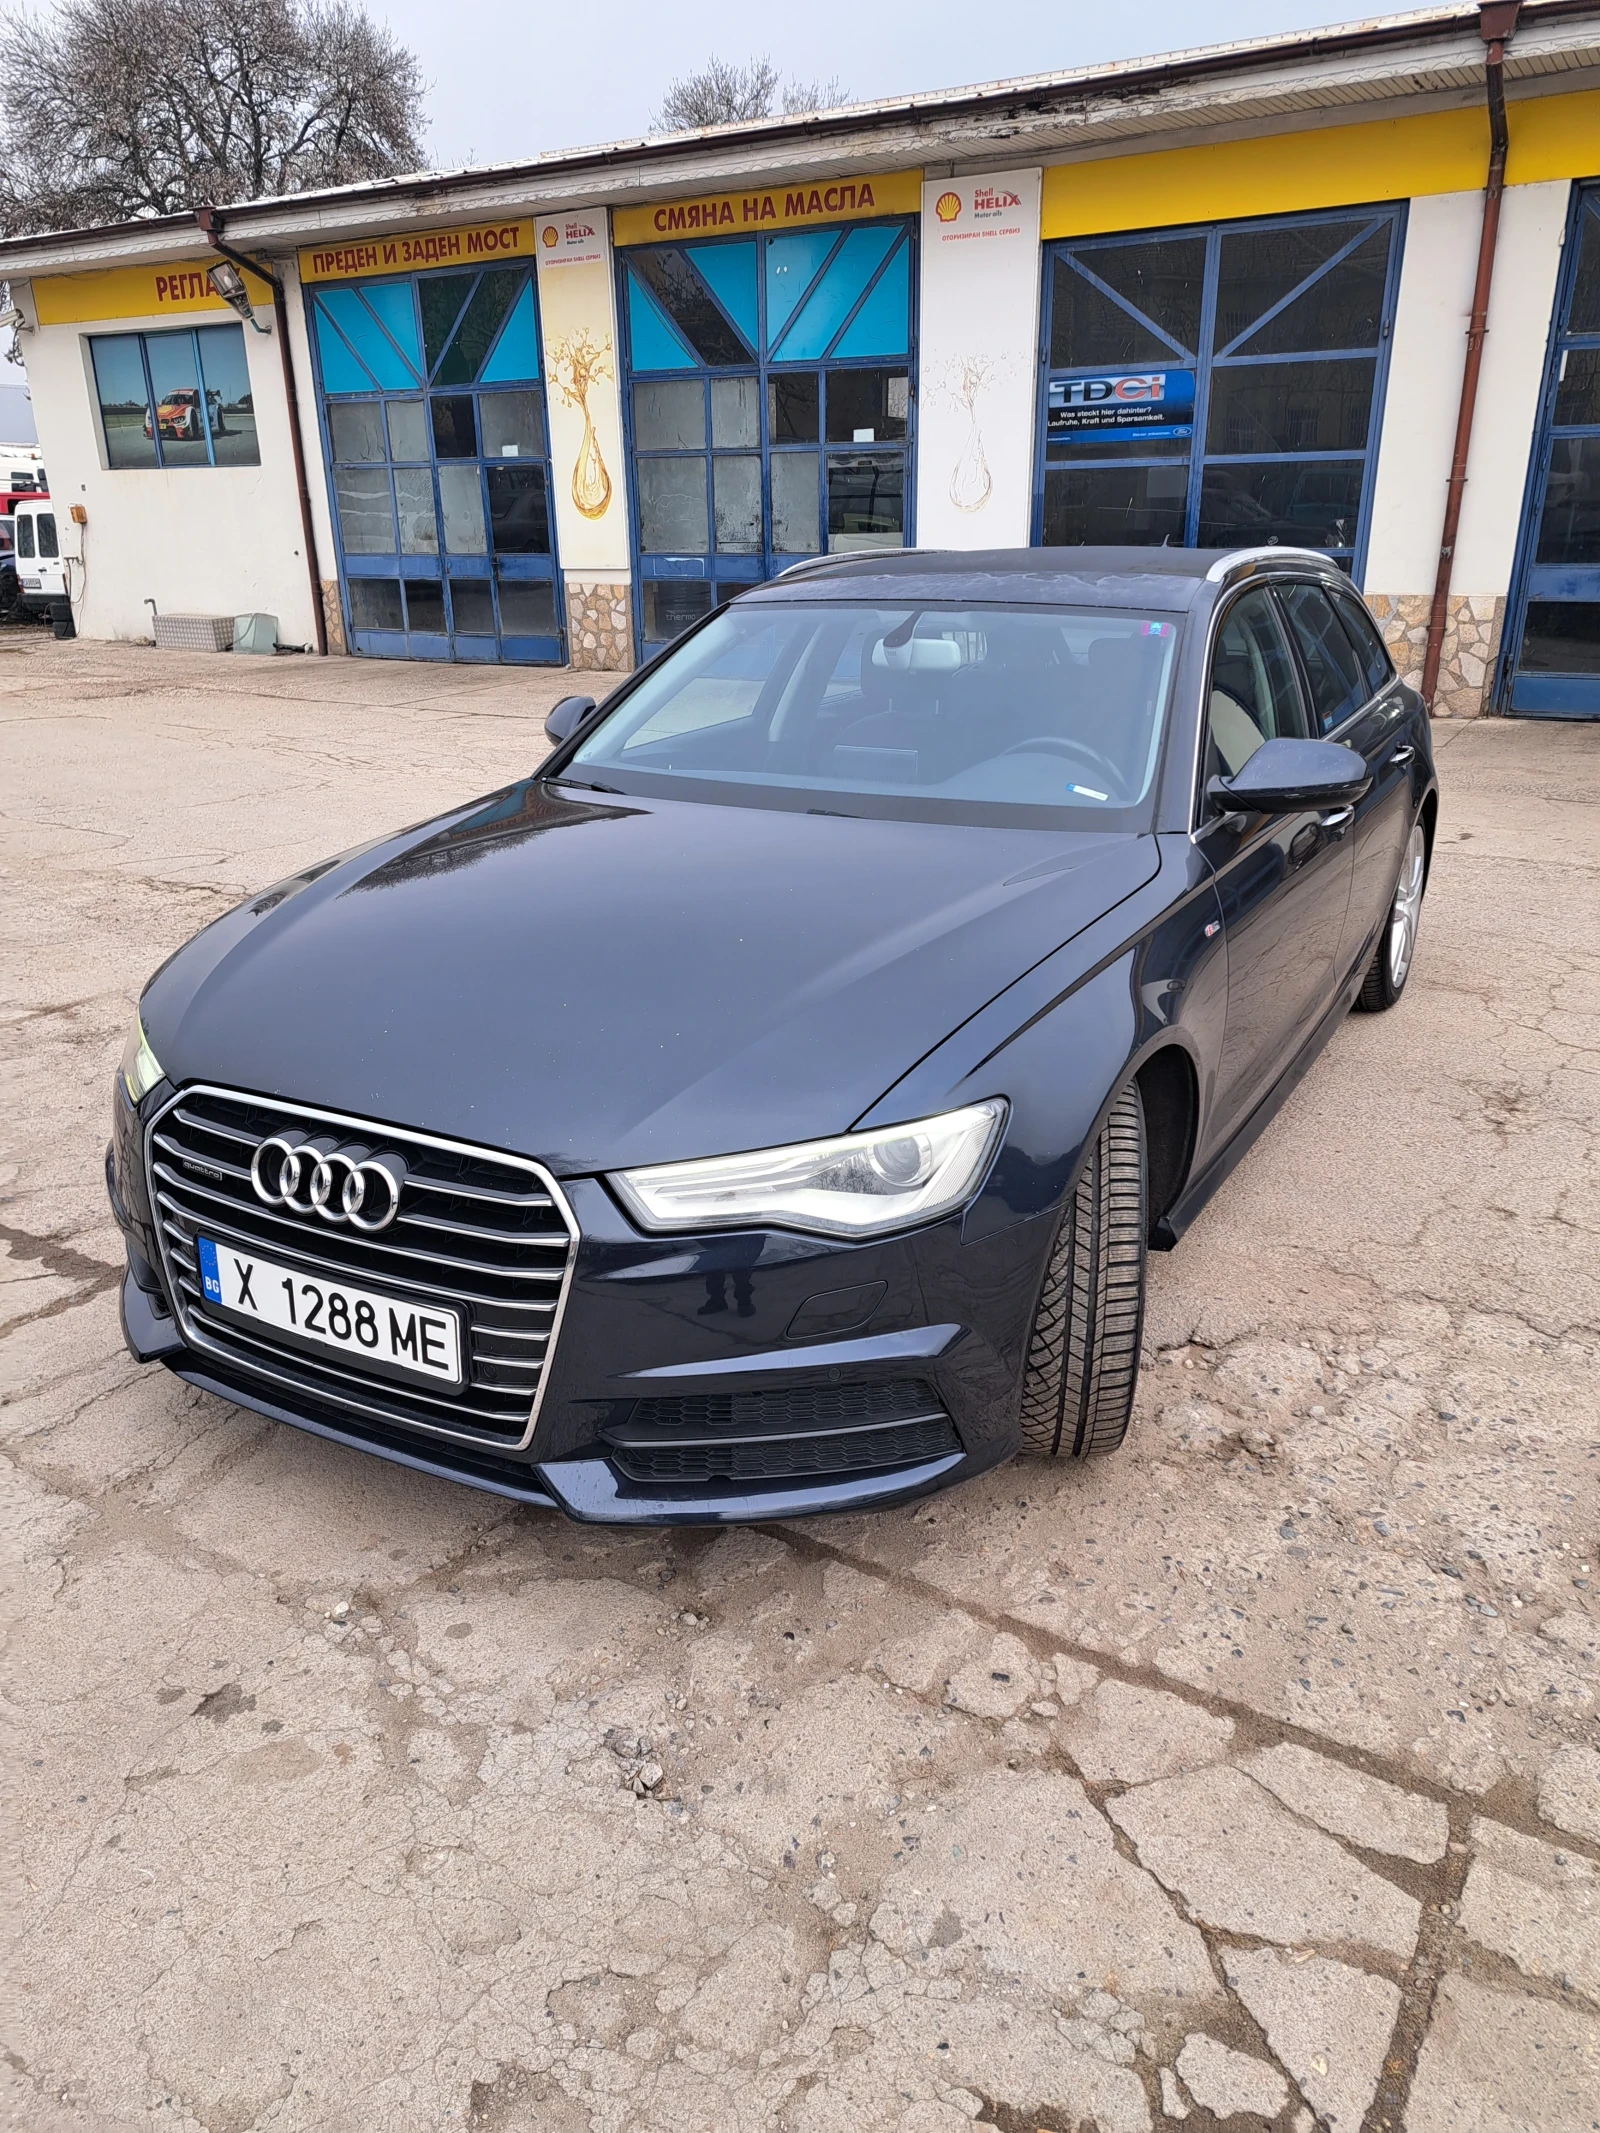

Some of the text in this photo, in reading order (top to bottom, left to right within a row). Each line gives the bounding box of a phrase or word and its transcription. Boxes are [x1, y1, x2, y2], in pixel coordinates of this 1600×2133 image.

[974, 187, 994, 198] Shell
[653, 183, 875, 232] СМЯНА НА МАСЛА
[974, 194, 1020, 210] HELIX
[565, 222, 577, 230] Shell
[565, 227, 595, 239] HELIX
[942, 232, 980, 241] ОТОРИЗИРАН
[999, 227, 1020, 236] СЕРВИЗ
[312, 227, 520, 273] ПРЕДЕН И ЗАДЕН МОСТ
[1054, 376, 1160, 404] TDCi
[1077, 409, 1099, 417] steckt
[1117, 407, 1152, 415] dahinter?
[1047, 419, 1080, 427] Laufruhe,
[1081, 417, 1100, 425] Kraft
[1117, 414, 1165, 423] Sparsamkeit.
[183, 1161, 220, 1178] quattro
[205, 1277, 220, 1293] BG
[233, 1258, 449, 1371] X 1288 ME
